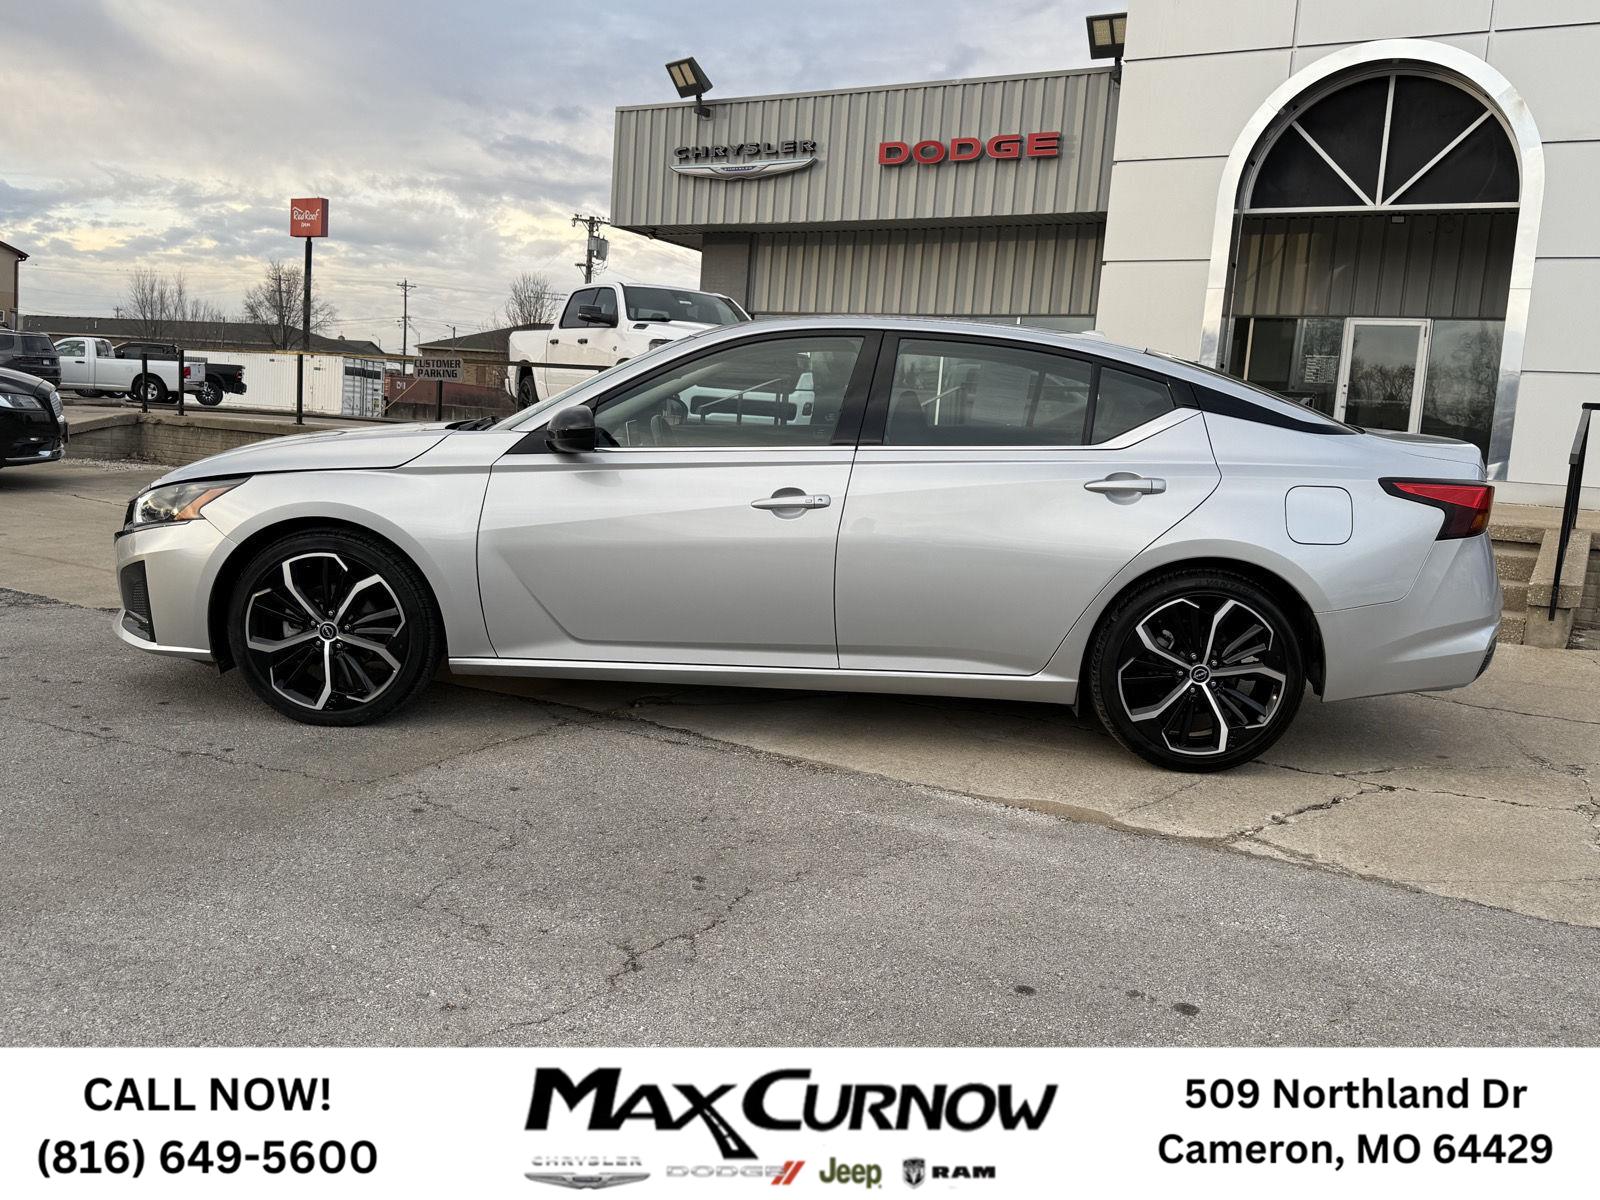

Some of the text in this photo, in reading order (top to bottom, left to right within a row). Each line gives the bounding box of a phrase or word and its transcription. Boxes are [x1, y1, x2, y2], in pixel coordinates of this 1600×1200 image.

[674, 140, 816, 159] CHRYSLER
[879, 132, 1060, 165] DODGE
[415, 359, 461, 368] CUSTOMER
[417, 368, 457, 378] PARKING
